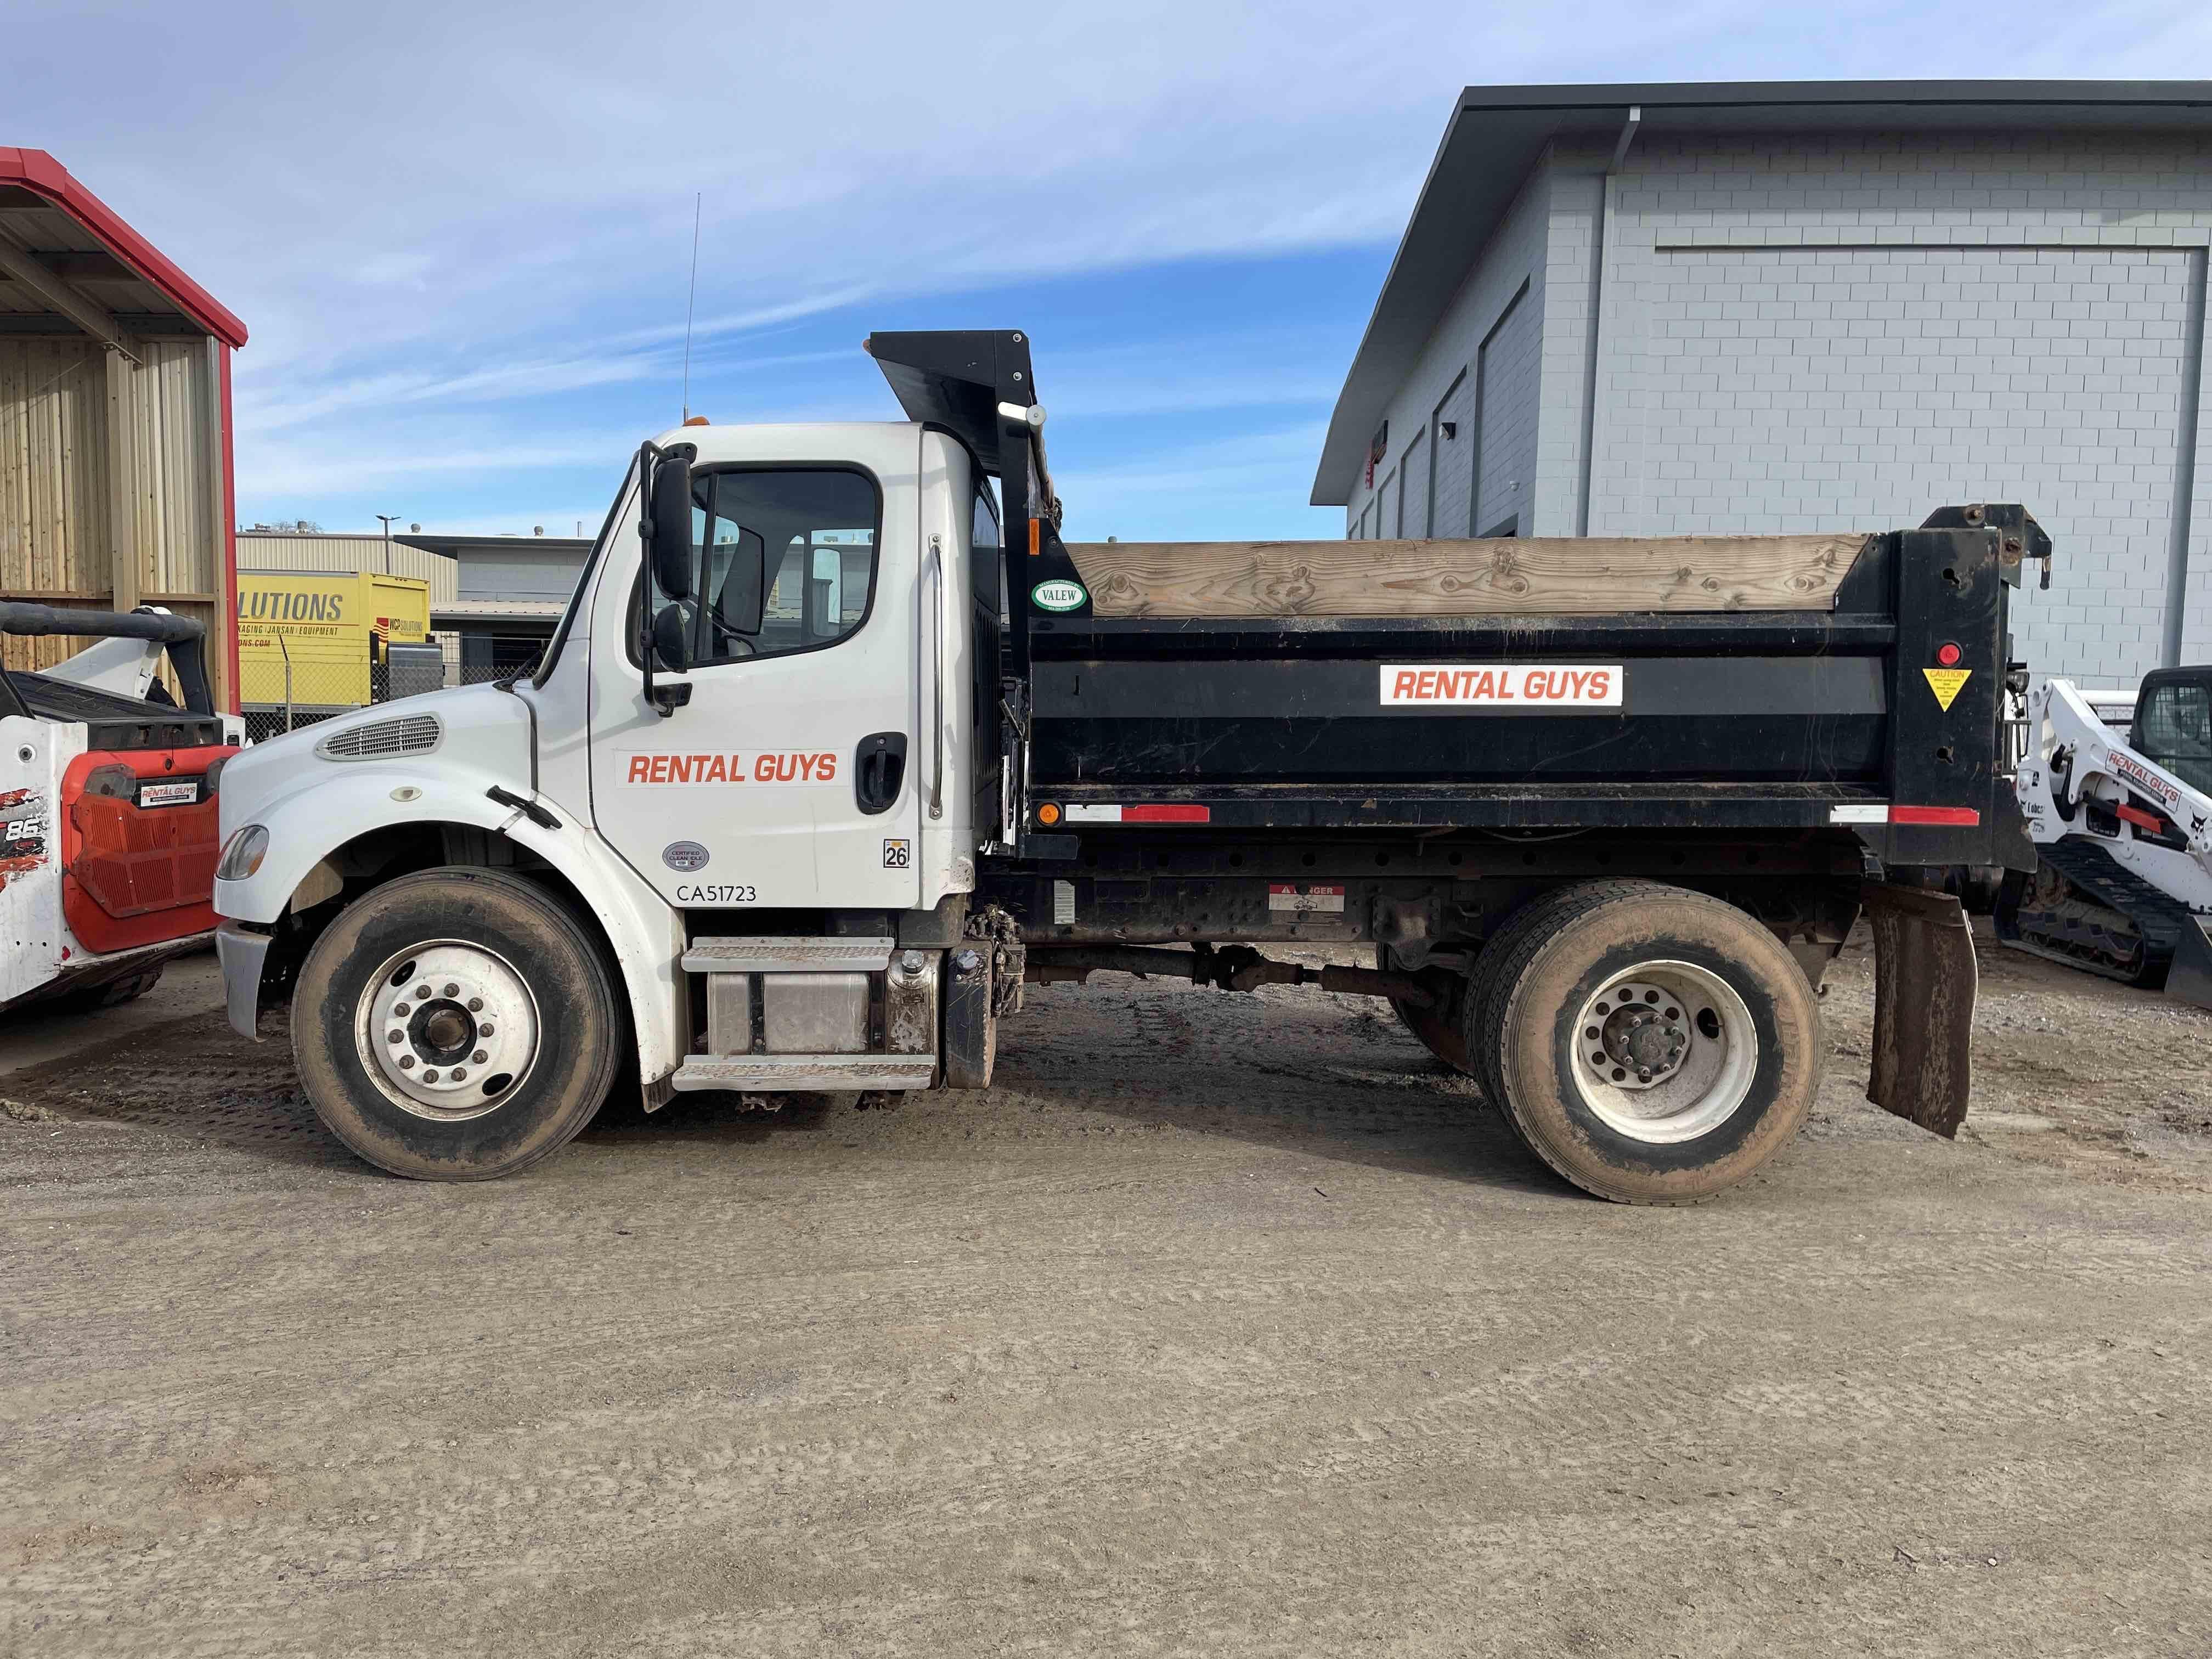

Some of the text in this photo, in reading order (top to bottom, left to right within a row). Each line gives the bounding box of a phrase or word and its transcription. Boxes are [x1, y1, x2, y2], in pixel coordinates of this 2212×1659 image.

[1042, 590, 1076, 601] VALEW
[238, 592, 343, 621] LUTIONS
[267, 626, 295, 635] JANSAN
[300, 627, 338, 636] EQUIPMENT
[1393, 671, 1610, 699] RENTAL GUYS
[628, 754, 837, 783] RENTAL GUYS
[2108, 753, 2148, 783] RENTAL
[2149, 777, 2179, 802] GUYS
[143, 786, 196, 798] RENTAL GUYS
[886, 847, 907, 866] 26
[677, 885, 757, 902] CA51723
[1294, 887, 1333, 895] NGER
